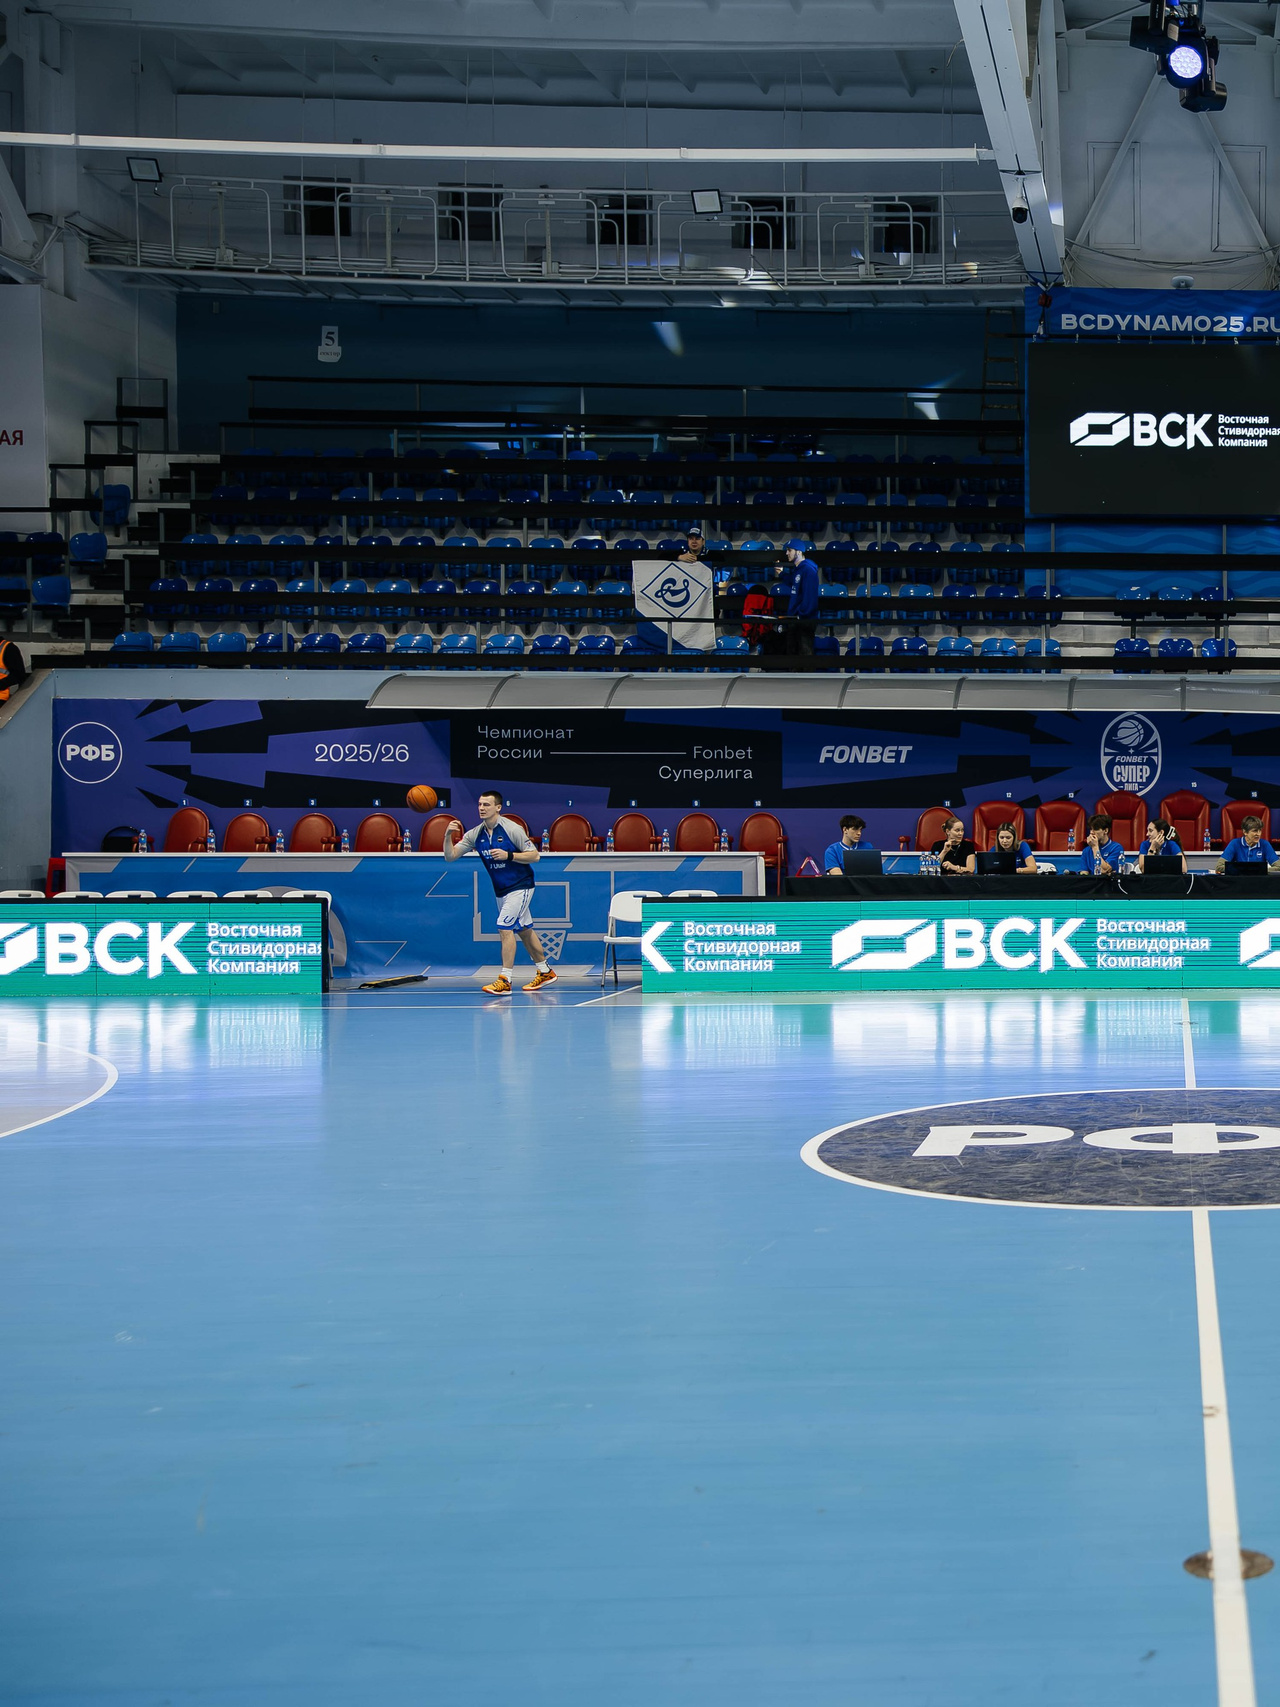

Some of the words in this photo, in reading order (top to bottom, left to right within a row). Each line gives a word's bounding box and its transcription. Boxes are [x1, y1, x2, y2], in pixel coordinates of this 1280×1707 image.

[325, 331, 335, 347] 5
[1218, 414, 1269, 424] Восточная
[1133, 412, 1214, 450] ВСК
[1218, 437, 1268, 447] Компания
[477, 725, 574, 741] Чемпионат
[66, 744, 115, 762] РФБ
[314, 742, 410, 764] 2025/26
[477, 745, 543, 759] России
[693, 745, 753, 760] Fonbet
[819, 745, 913, 764] FONBET
[1115, 755, 1149, 763] FONBET
[658, 765, 754, 783] Суперлига
[1113, 765, 1150, 783] СУПЕР
[1124, 783, 1139, 791] ЛИГА
[207, 922, 303, 938] Восточная
[684, 921, 777, 936] Восточная
[1096, 918, 1186, 933] Восточная
[44, 921, 198, 978] ВСК
[683, 938, 801, 957] Стивидорная
[943, 917, 1088, 973] ВСК
[1096, 936, 1210, 953] Стивидорная
[207, 958, 301, 973] Компания
[684, 957, 774, 972] Компания
[1096, 954, 1183, 969] Компания
